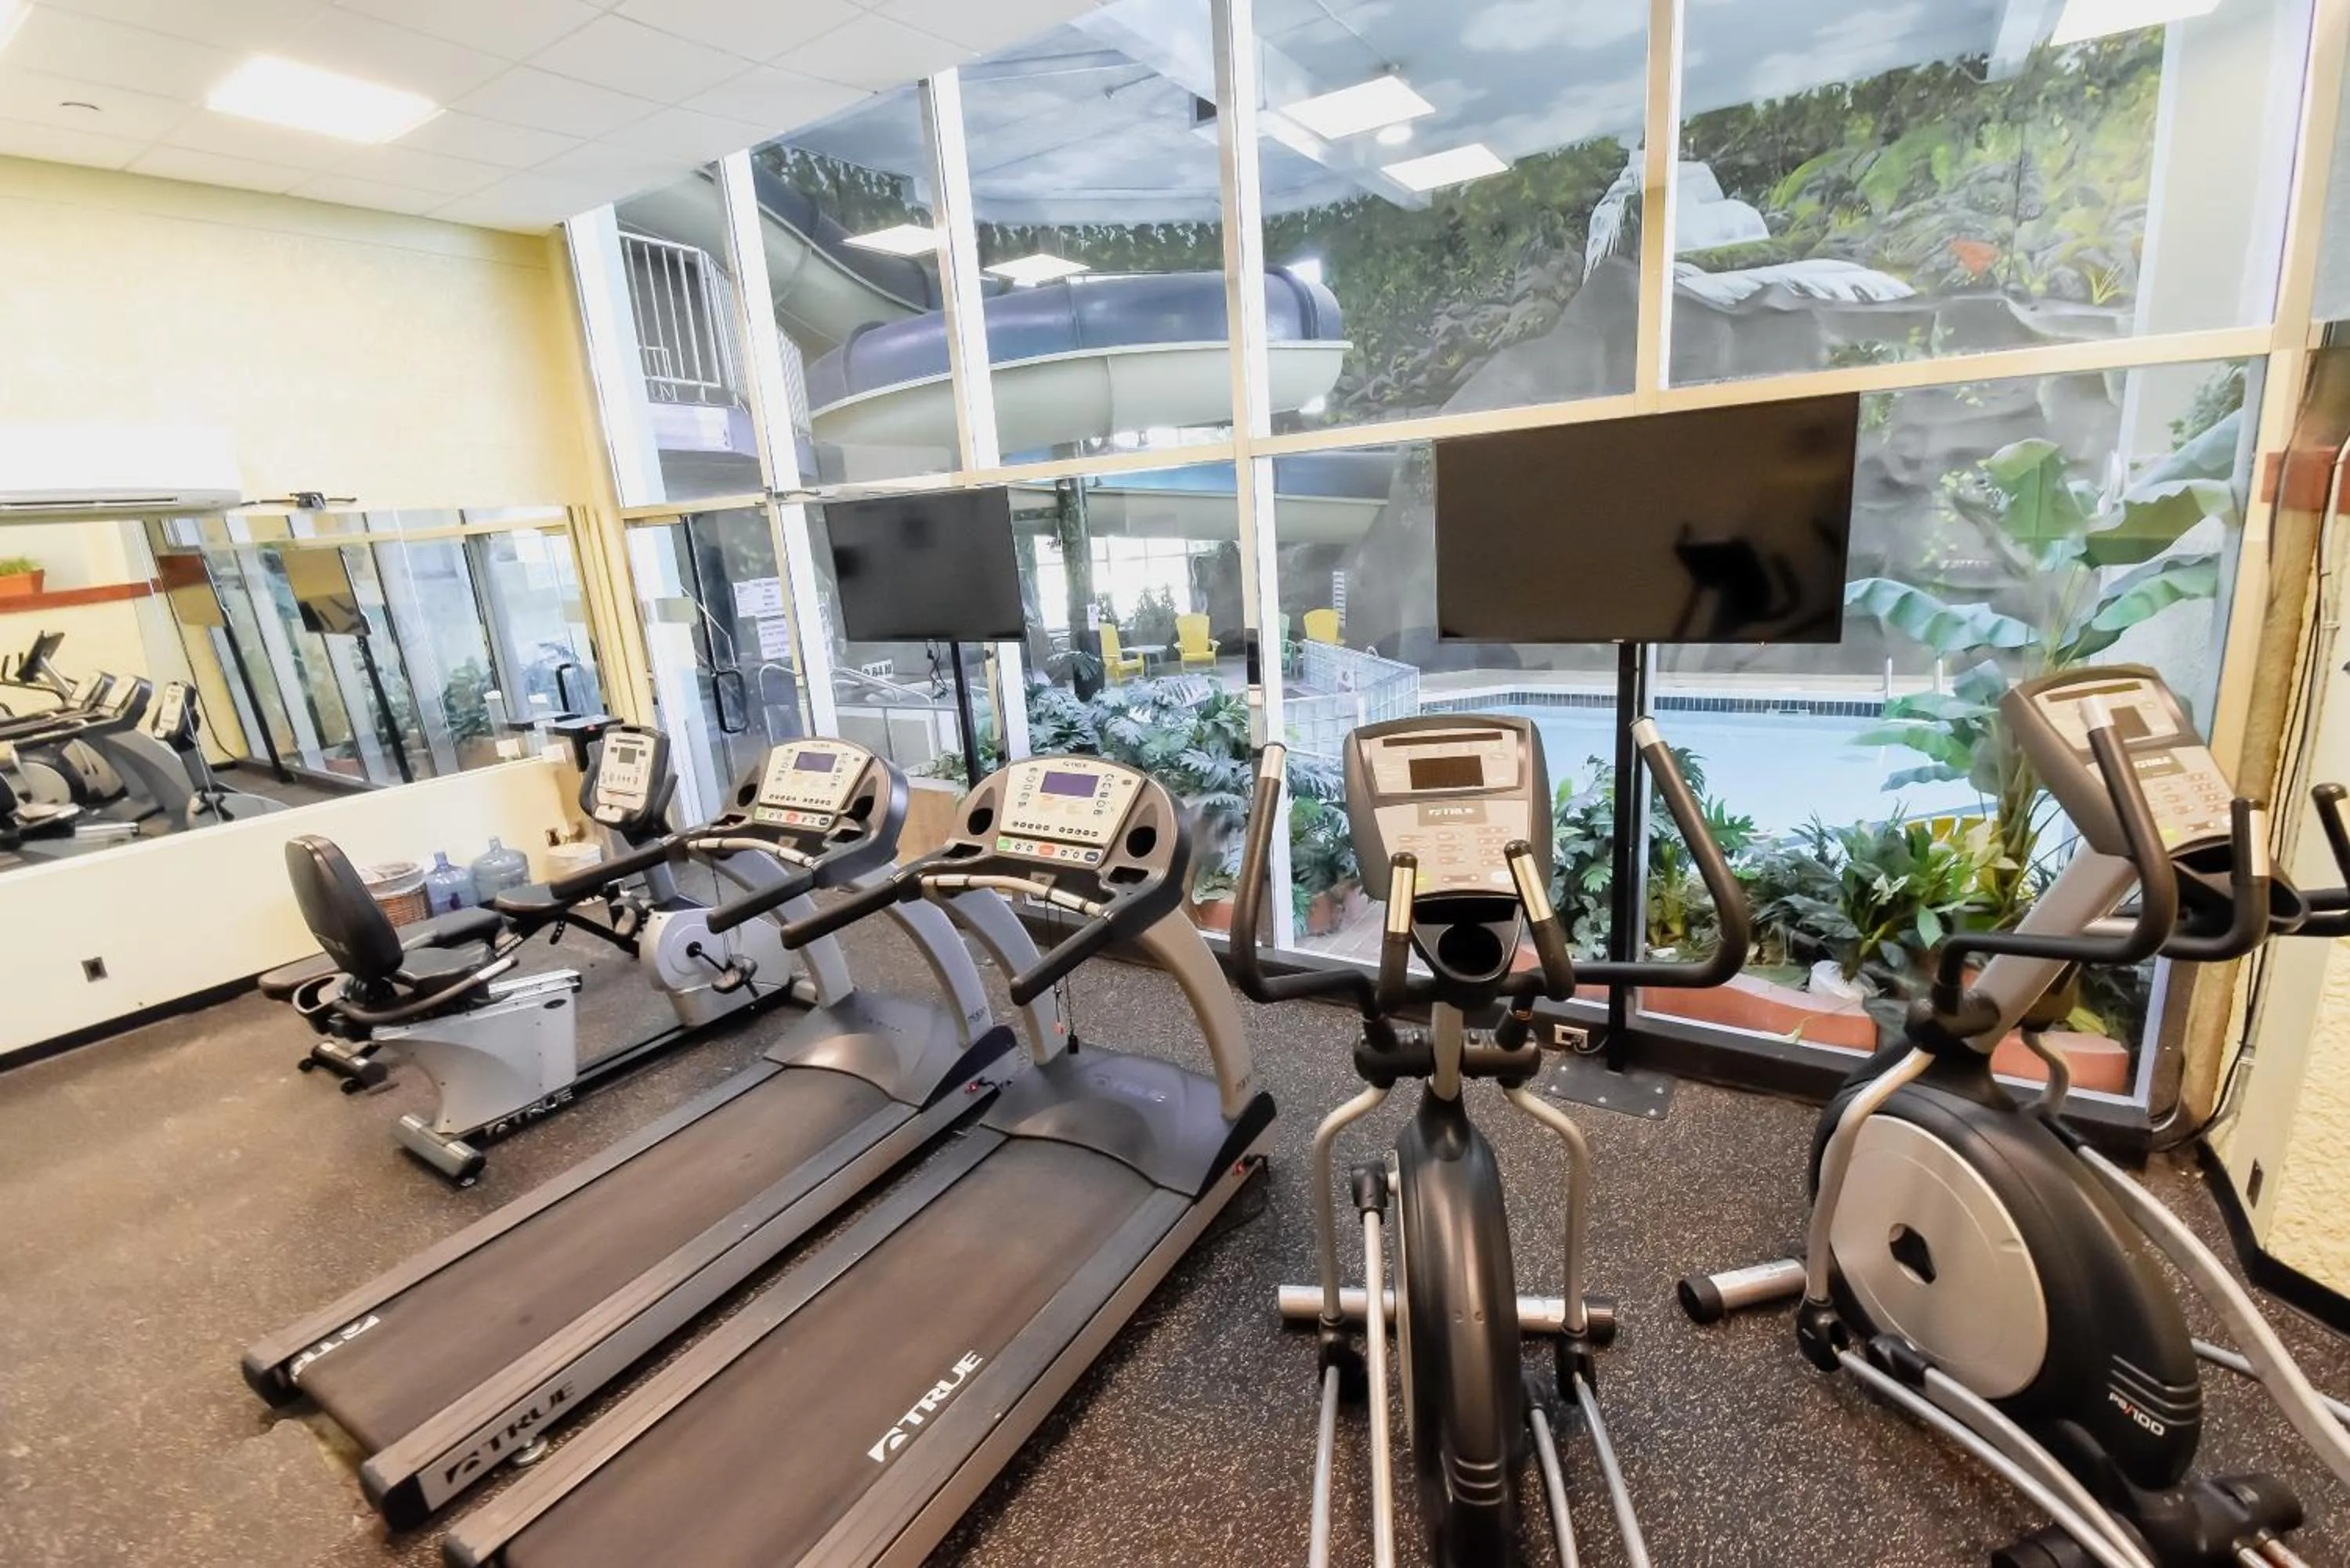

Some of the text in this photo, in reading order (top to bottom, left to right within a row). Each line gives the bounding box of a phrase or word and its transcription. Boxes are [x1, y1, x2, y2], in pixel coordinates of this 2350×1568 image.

[505, 1088, 573, 1124] TRUE
[482, 1380, 575, 1451] TRUE
[897, 1350, 983, 1425] TRUE
